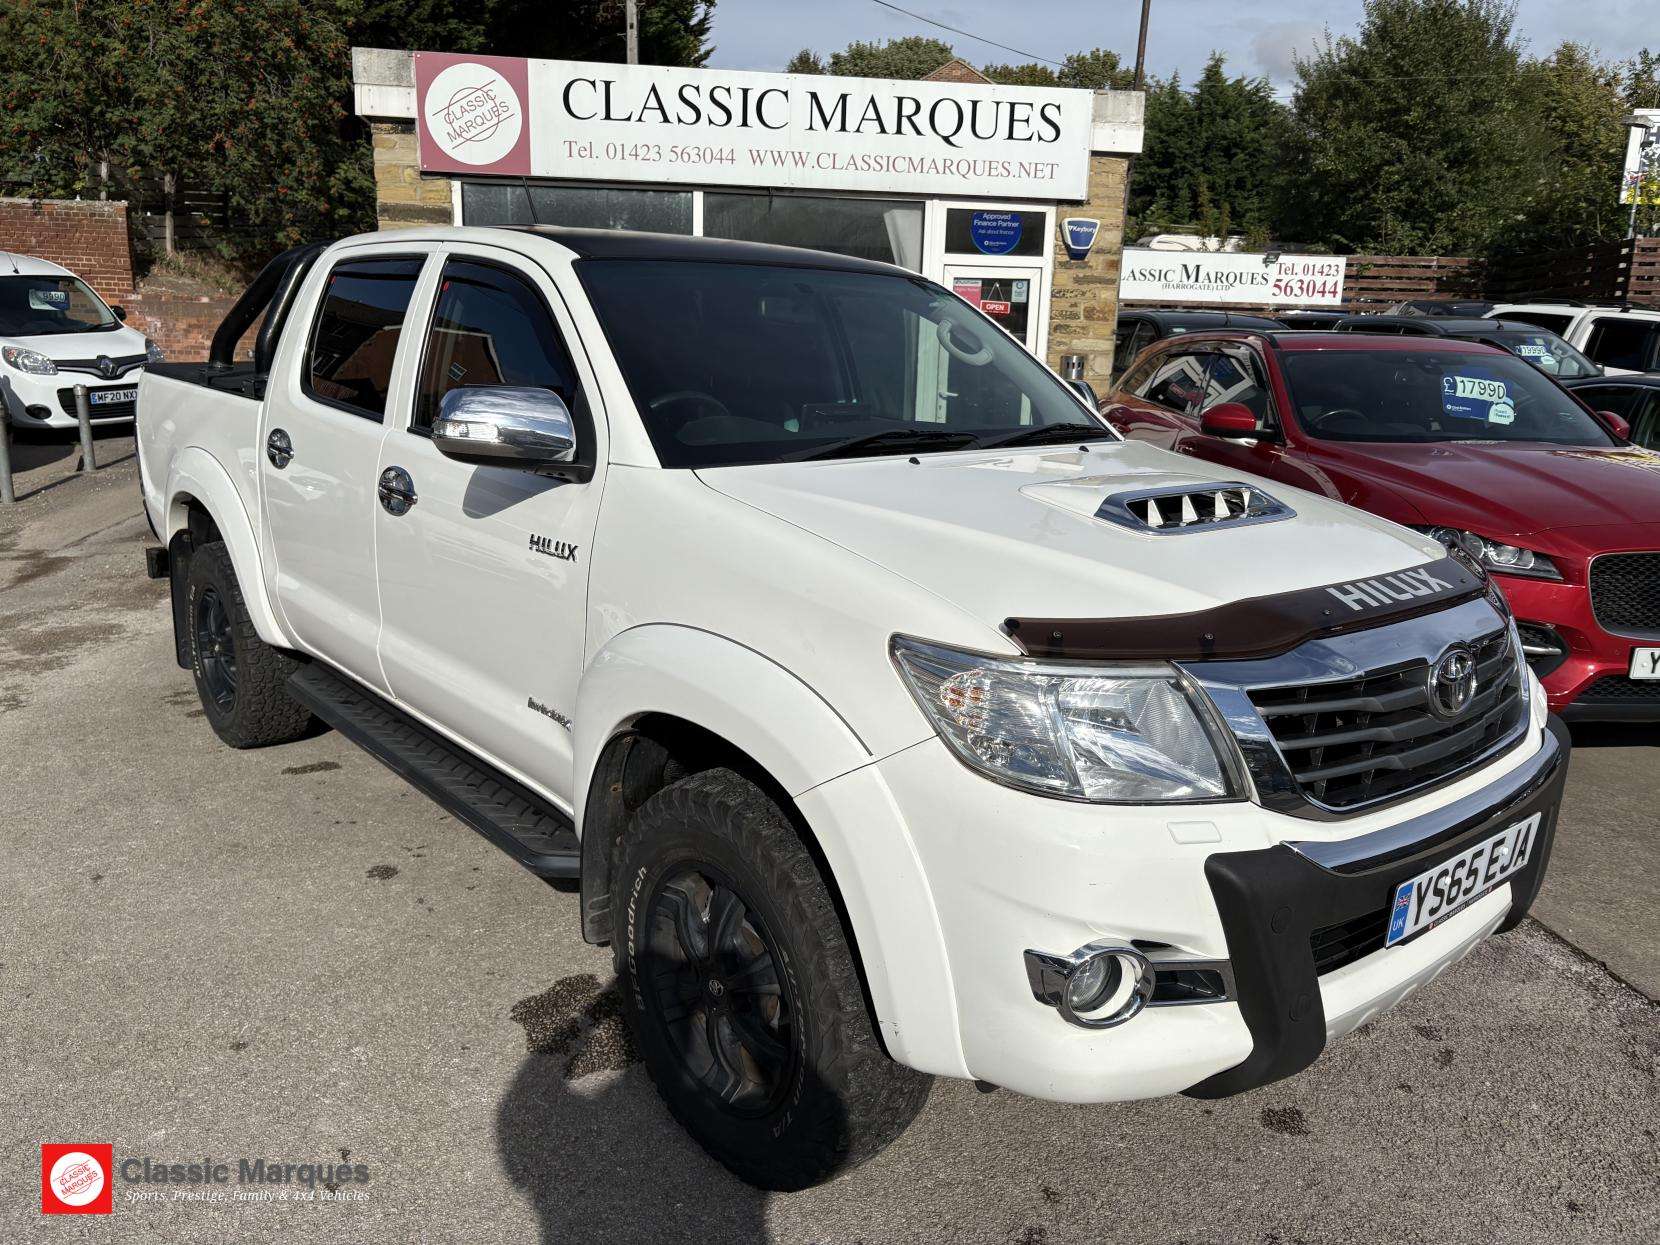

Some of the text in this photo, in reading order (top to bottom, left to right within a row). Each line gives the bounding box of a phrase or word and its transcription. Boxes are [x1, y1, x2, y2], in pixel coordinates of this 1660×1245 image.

[444, 89, 496, 124] CLASSIC
[562, 78, 1062, 148] CLASSIC MARQUES
[447, 101, 510, 142] MARQUES
[563, 140, 1060, 181] Tel. 01423 563044 WWW.CLASSICMARQUES.NET
[1180, 264, 1269, 287] MARQUES
[1276, 262, 1340, 277] Tel. 01423
[1162, 283, 1231, 292] (HARROGATE) LTD
[1271, 278, 1339, 298] 563044
[986, 303, 1005, 311] OPEN
[529, 533, 579, 562] HILUX
[1325, 568, 1454, 611] HILUX
[1413, 848, 1485, 926] YS65
[1482, 822, 1533, 886] EJA
[1392, 916, 1405, 931] UK
